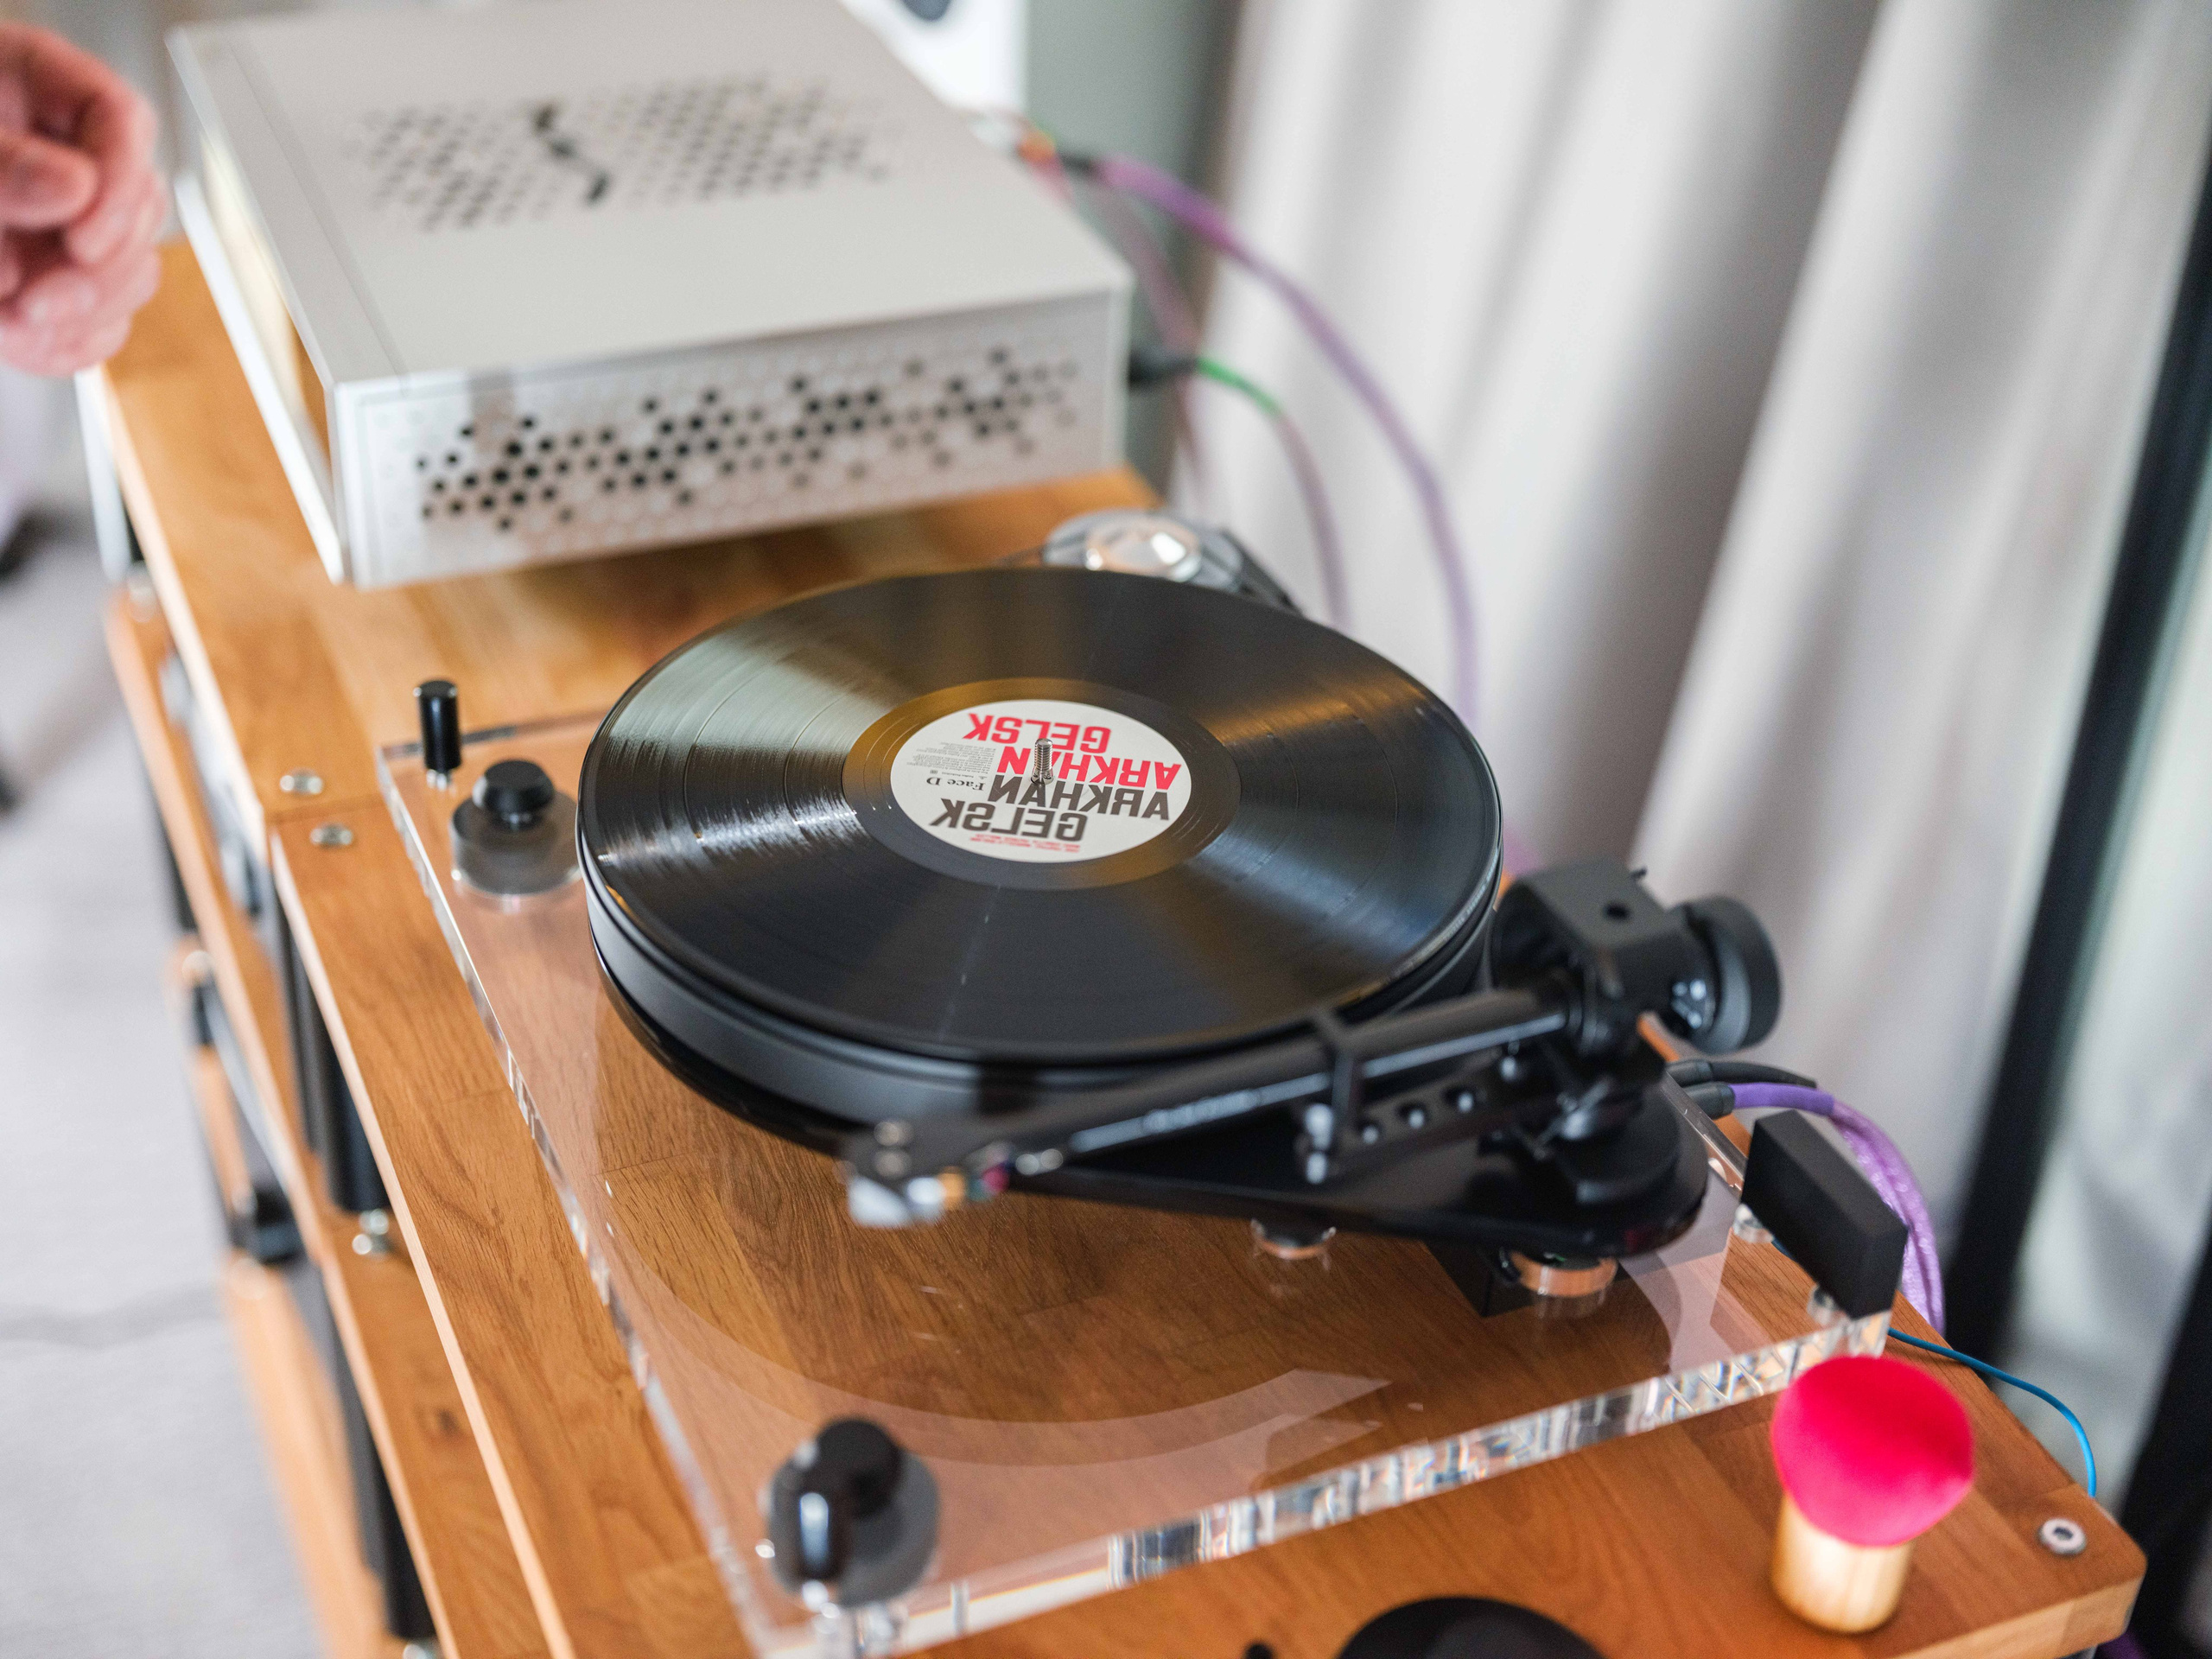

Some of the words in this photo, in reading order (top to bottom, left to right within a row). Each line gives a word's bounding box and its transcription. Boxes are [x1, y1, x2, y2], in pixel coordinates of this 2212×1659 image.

[962, 713, 1111, 754] GELSK
[926, 777, 941, 786] D
[946, 778, 986, 791] Face
